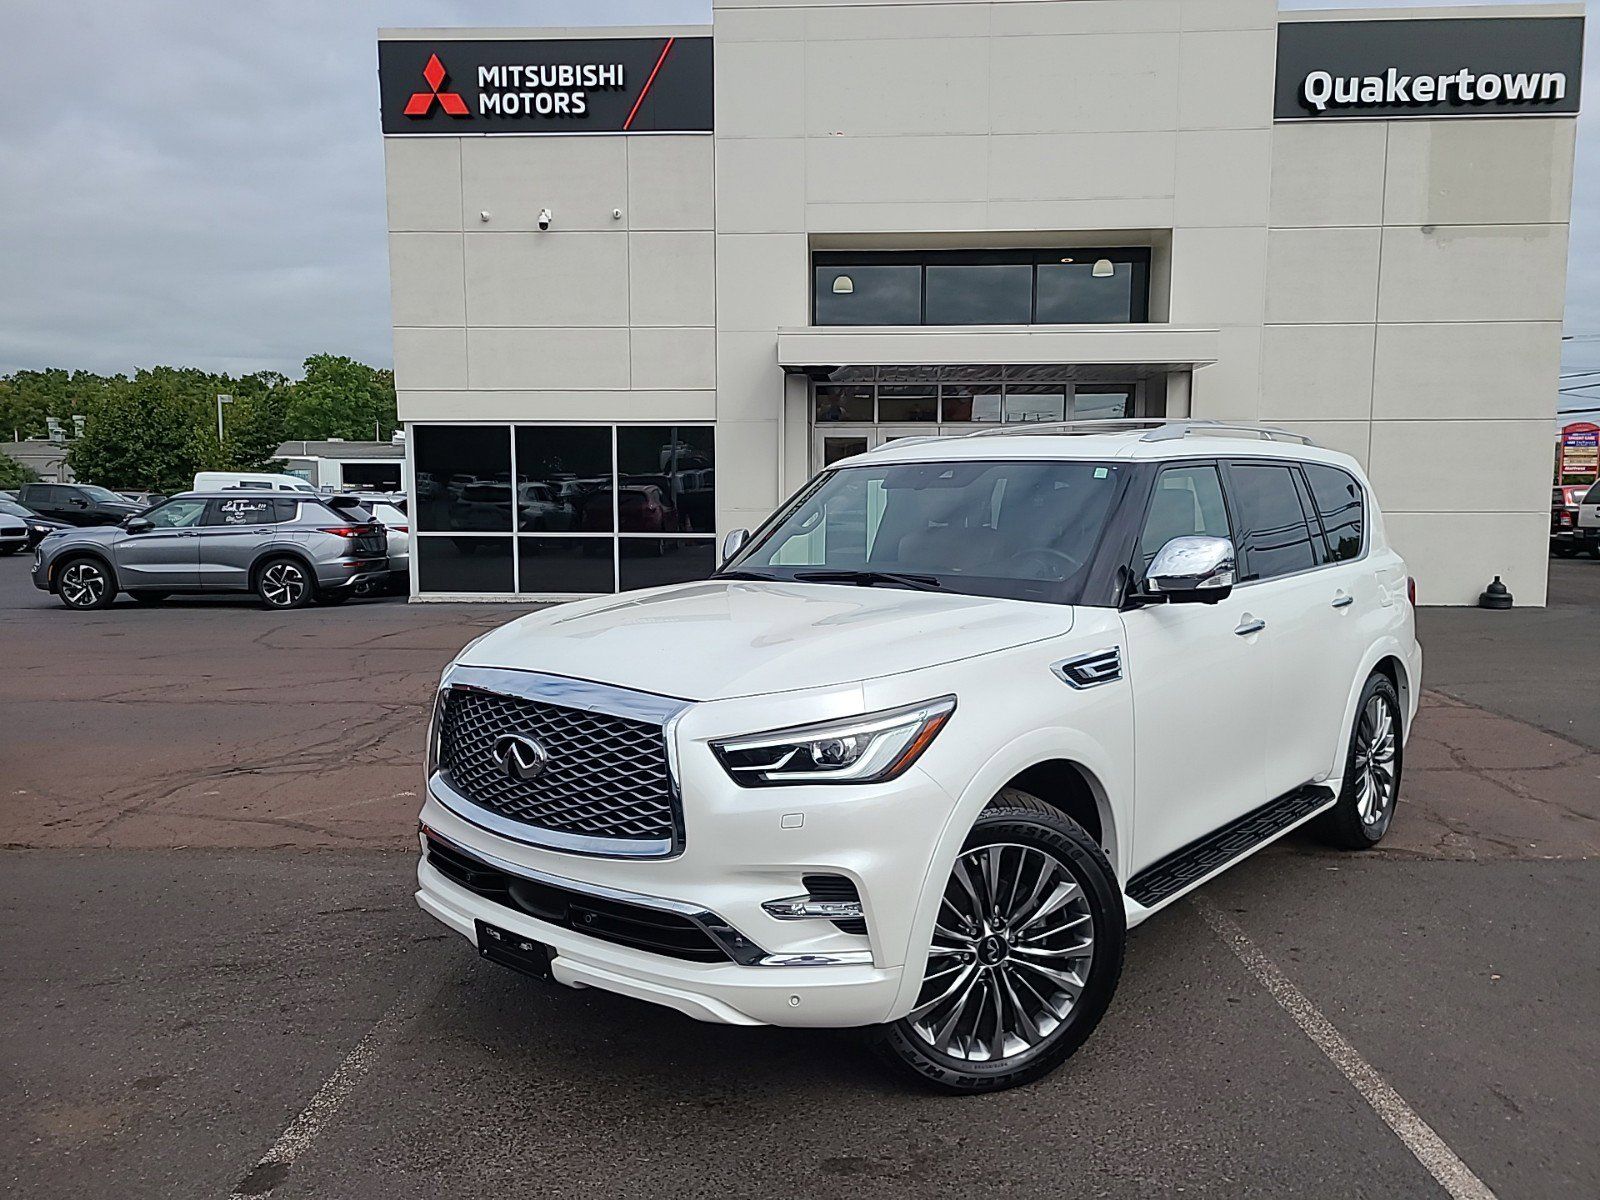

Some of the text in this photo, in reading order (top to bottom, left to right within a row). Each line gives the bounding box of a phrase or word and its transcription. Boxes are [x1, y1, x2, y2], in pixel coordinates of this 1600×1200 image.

[478, 64, 624, 87] MITSUBISHI
[1304, 67, 1567, 110] Quakertown
[479, 92, 586, 114] MOTORS
